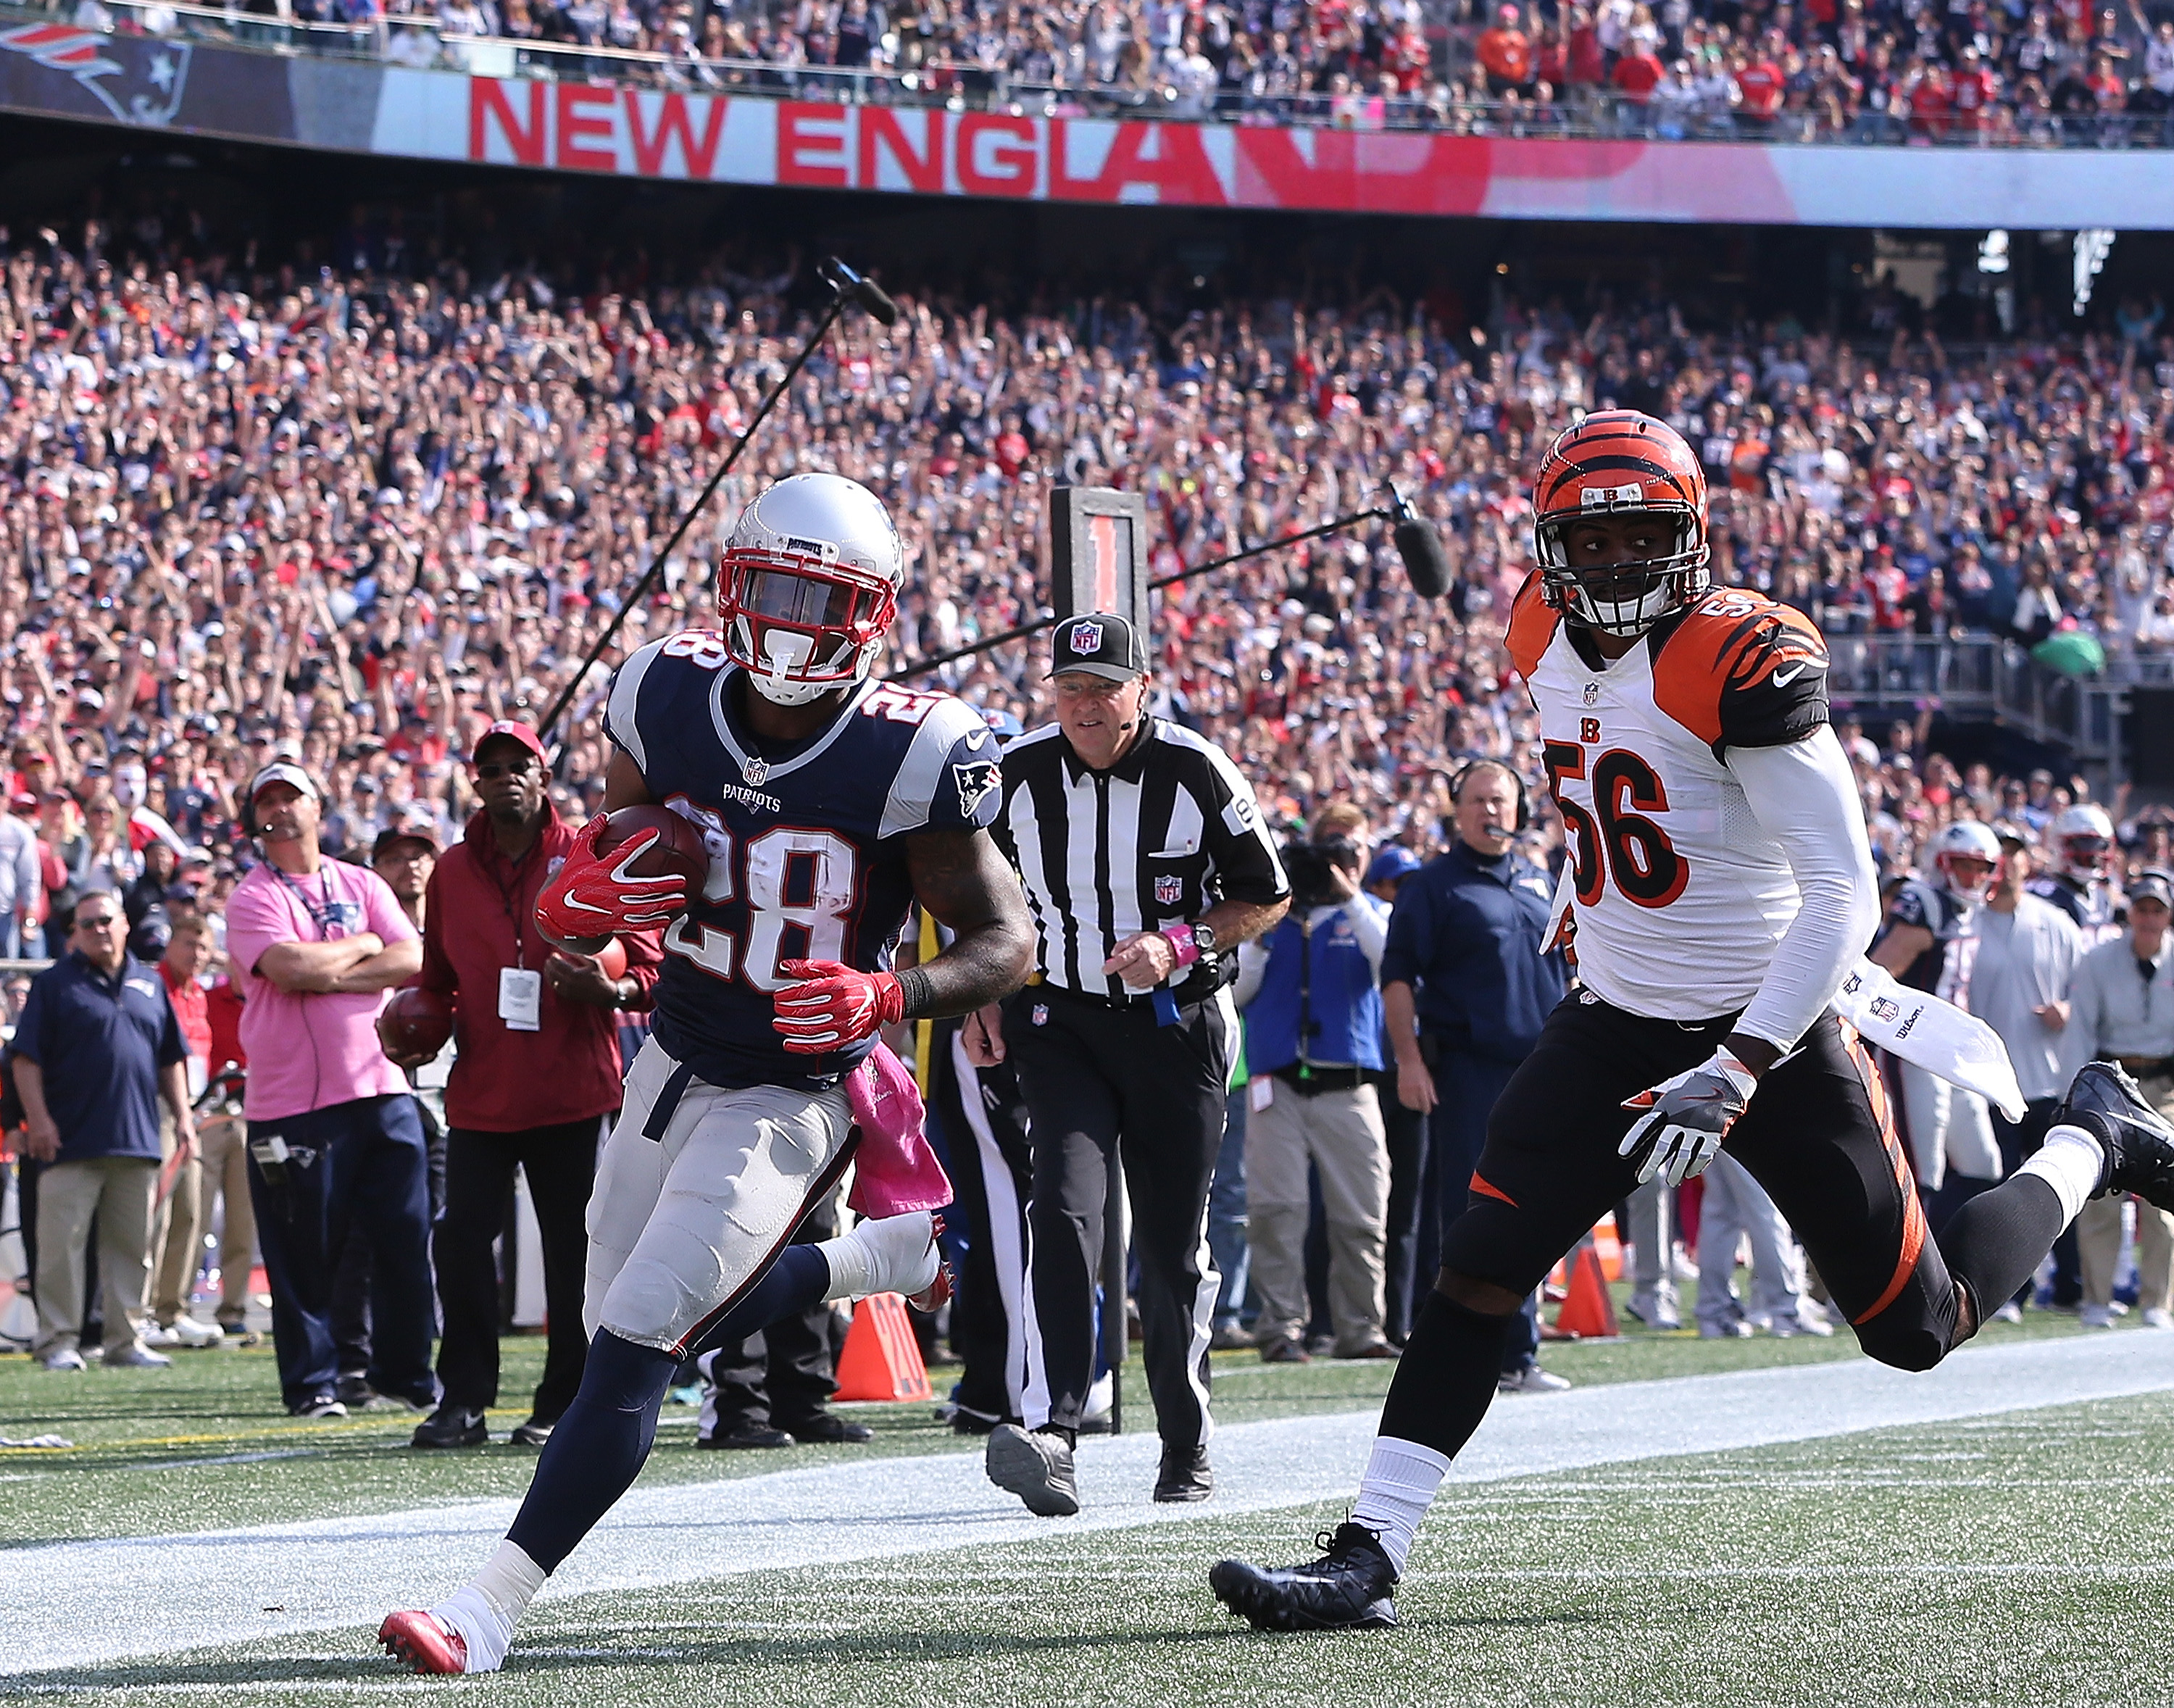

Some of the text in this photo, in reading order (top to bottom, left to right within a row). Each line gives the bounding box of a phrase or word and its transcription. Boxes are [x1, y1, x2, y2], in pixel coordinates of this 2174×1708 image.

[468, 75, 730, 180] NEW
[1088, 515, 1117, 615] 1
[1580, 717, 1601, 744] B
[723, 783, 782, 812] PATRIOTS
[1542, 738, 1691, 909] 56
[662, 791, 860, 994] 28
[1895, 1005, 1924, 1039] Wilson
